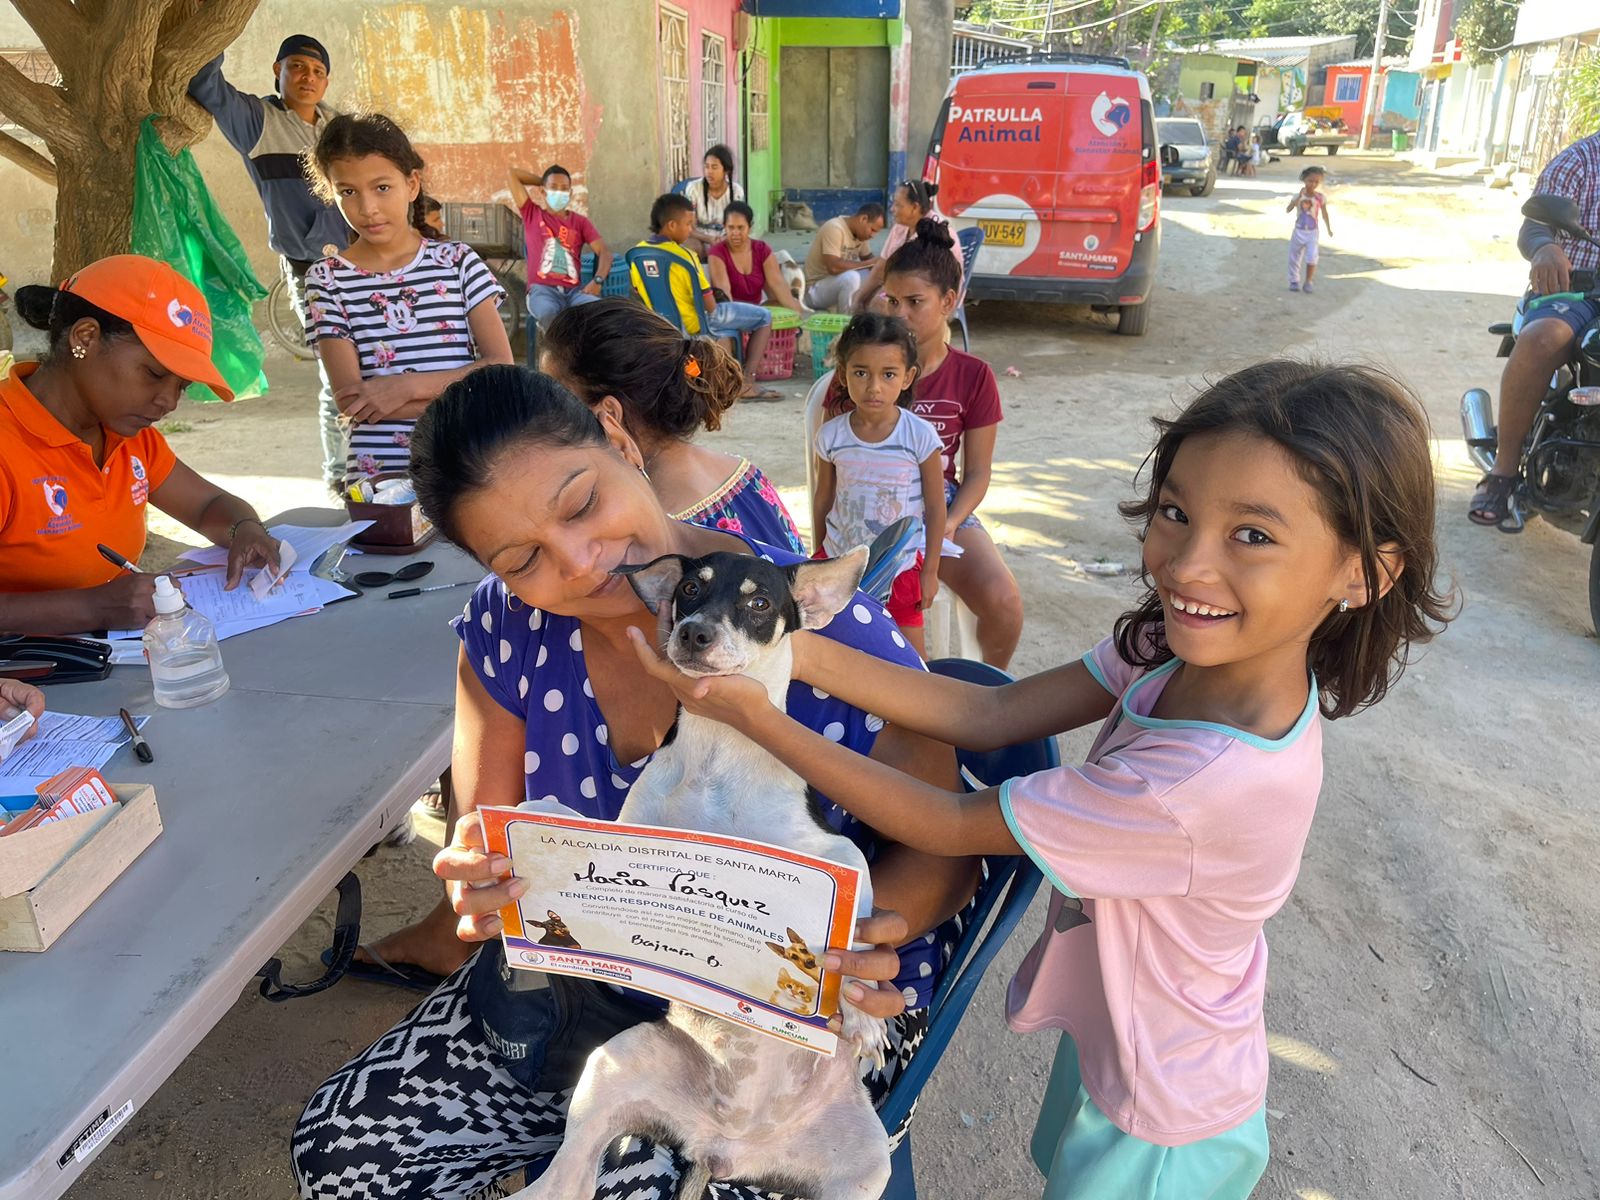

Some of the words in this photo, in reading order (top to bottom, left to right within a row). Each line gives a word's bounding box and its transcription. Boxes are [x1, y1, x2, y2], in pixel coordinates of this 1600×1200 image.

[948, 105, 1043, 123] PATRULLA
[958, 125, 1041, 143] Animal
[541, 835, 557, 845] LA
[562, 838, 623, 852] ALCALDÍA
[628, 846, 692, 860] DISTRITAL
[695, 854, 712, 863] DE
[715, 857, 756, 872] SANTA
[758, 866, 801, 884] MARTA
[628, 862, 683, 875] CERTIFICA
[688, 869, 711, 879] QUE
[559, 890, 617, 902] TENENCIA
[620, 897, 706, 918] RESPONSABLE
[709, 911, 725, 923] DE
[727, 917, 785, 943] ANIMALES
[637, 891, 667, 899] manera
[668, 894, 715, 909] satisfactoria
[725, 905, 746, 916] curso
[748, 911, 757, 920] de
[628, 921, 663, 931] bienestar
[650, 917, 701, 933] mejoramiento
[722, 935, 755, 951] sociedad
[677, 916, 698, 925] mejor
[747, 935, 762, 946] que
